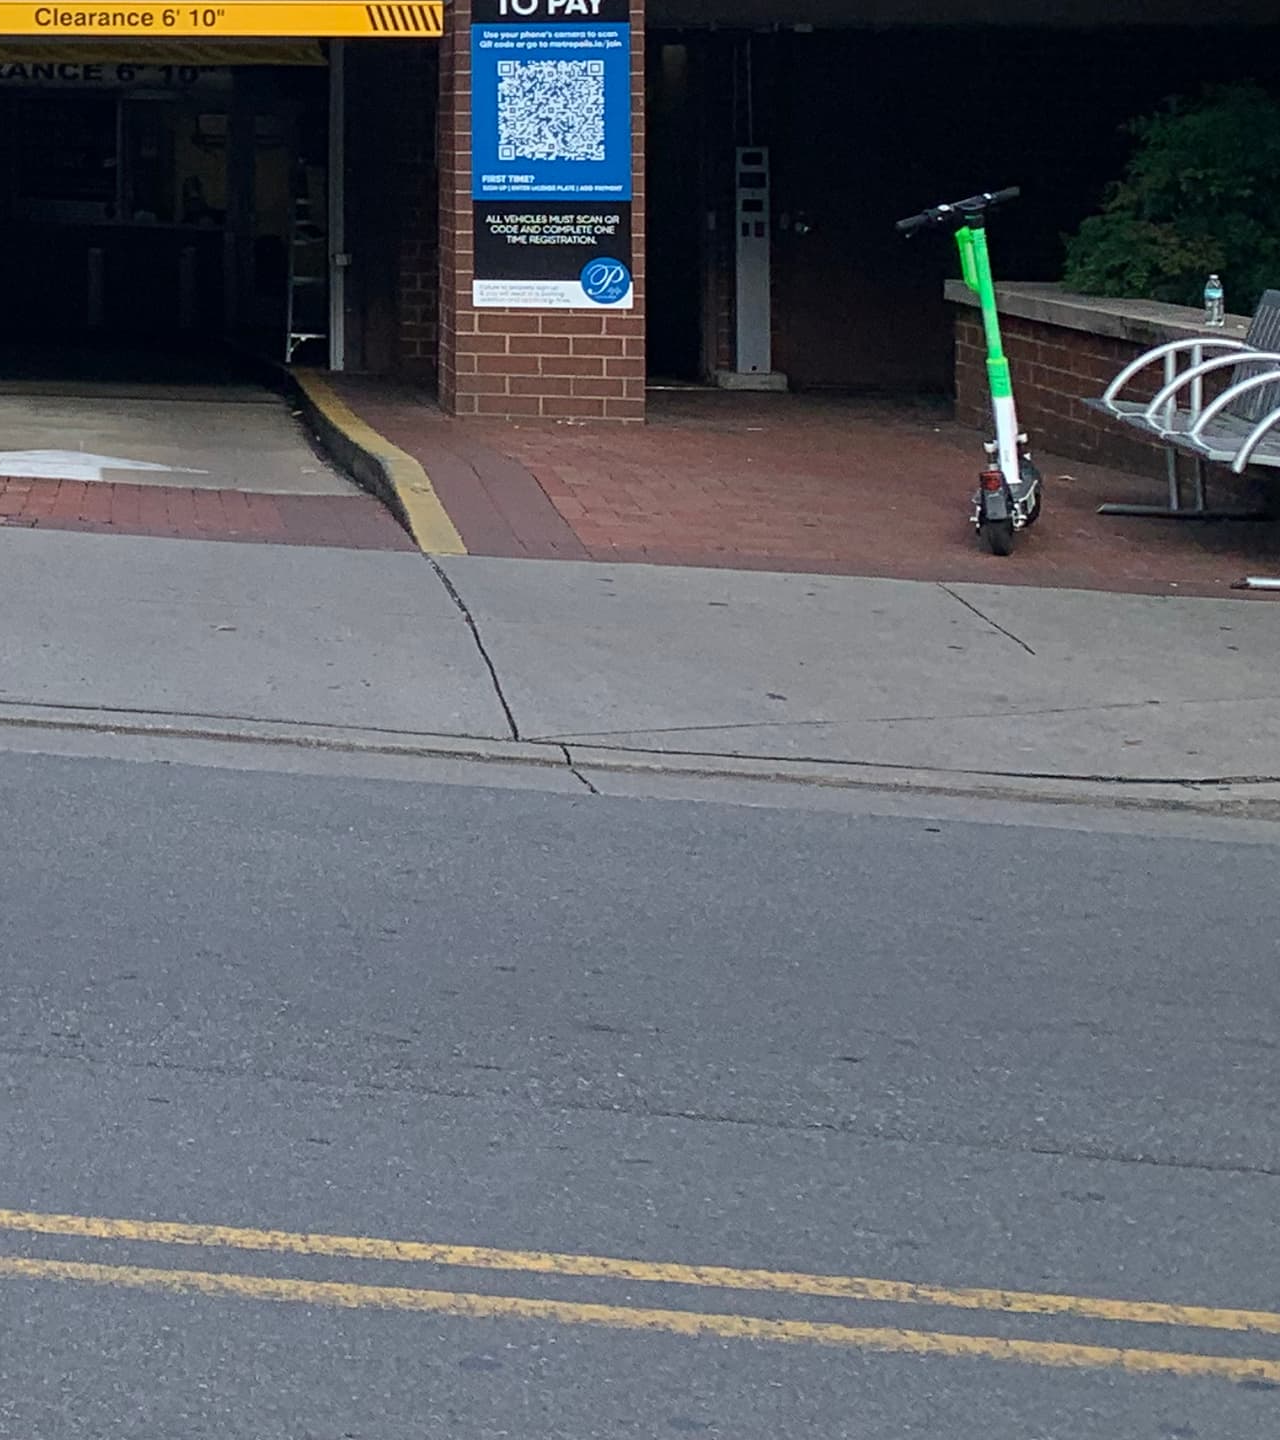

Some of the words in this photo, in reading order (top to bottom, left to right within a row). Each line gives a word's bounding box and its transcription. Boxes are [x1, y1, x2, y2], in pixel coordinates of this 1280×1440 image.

[34, 7, 154, 28] Clearance
[161, 8, 181, 28] 6'
[188, 9, 226, 28] 10"
[483, 31, 499, 39] Use
[500, 32, 519, 40] your
[520, 31, 553, 40] phone's
[479, 40, 493, 48] QR
[526, 41, 538, 50] go
[482, 174, 507, 184] FIRST
[508, 174, 536, 184] TIME?
[485, 214, 503, 224] ALL
[503, 214, 548, 224] VEHICLES
[548, 214, 575, 224] MUST
[576, 214, 603, 224] SCAN
[604, 215, 620, 224] QR
[490, 224, 519, 234] CODE
[520, 225, 542, 234] AND
[542, 225, 593, 234] COMPLETE
[594, 225, 616, 234] ONE
[506, 235, 528, 244] TIME
[528, 235, 598, 245] REGISTRATION.
